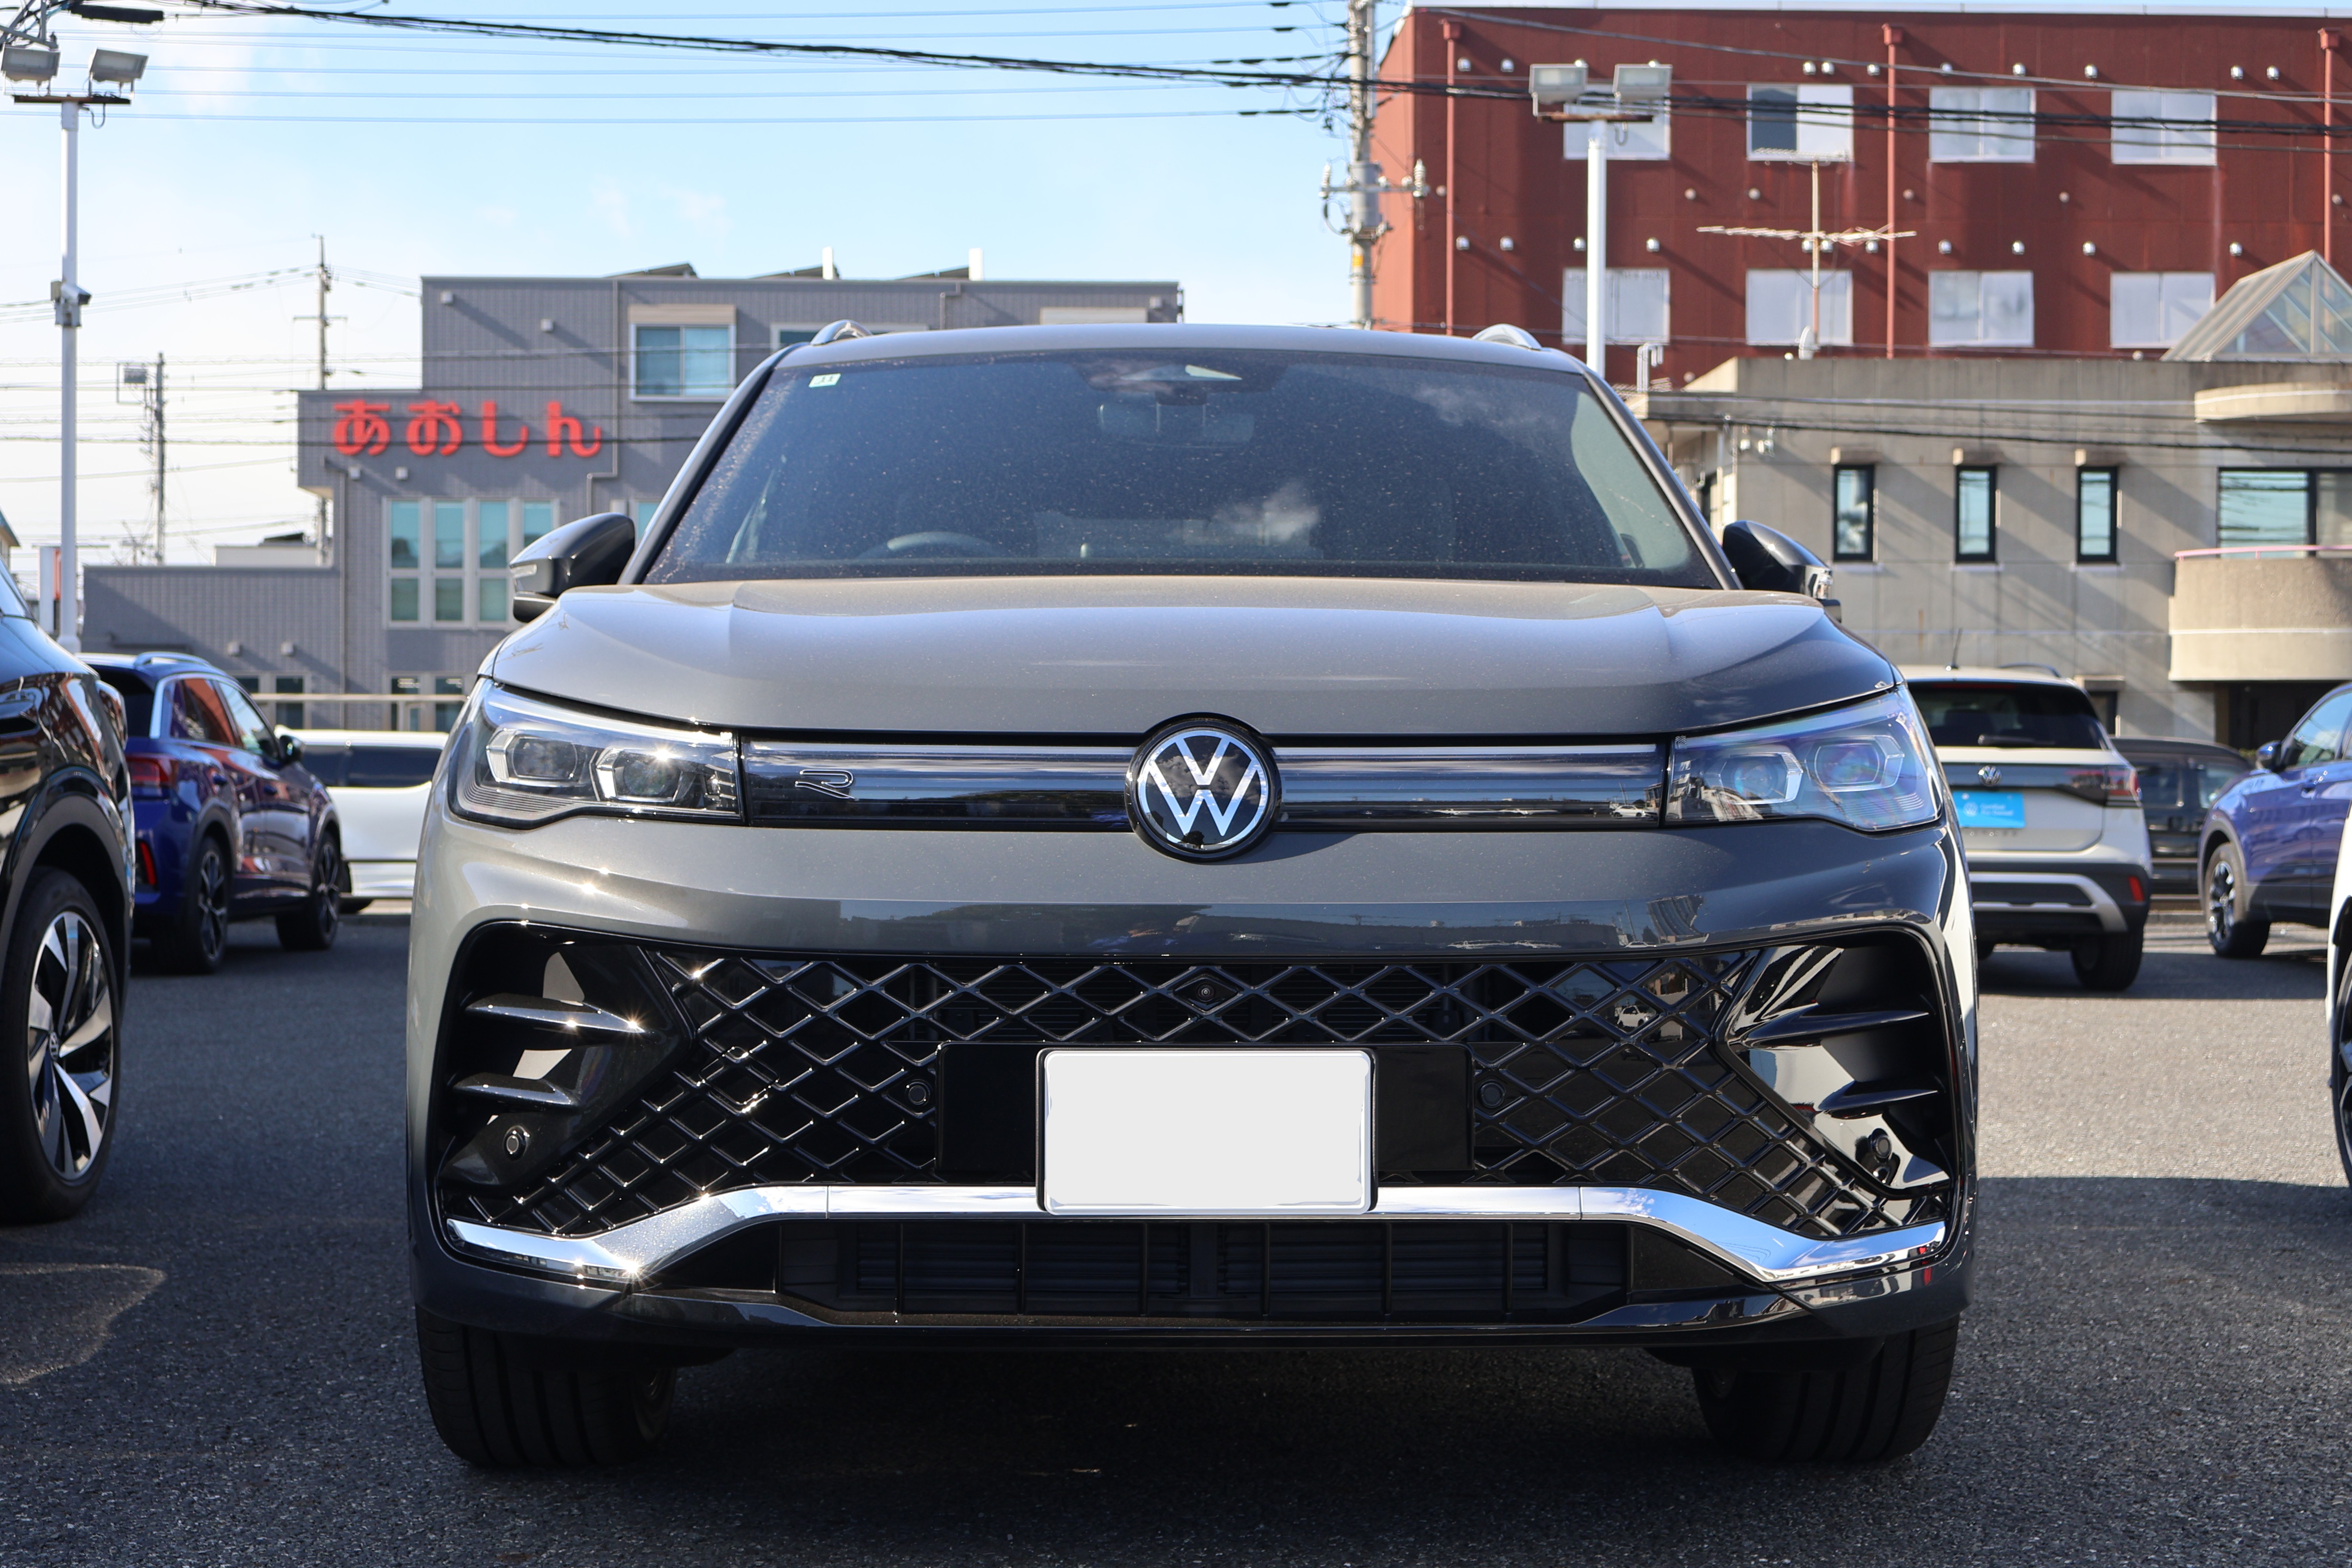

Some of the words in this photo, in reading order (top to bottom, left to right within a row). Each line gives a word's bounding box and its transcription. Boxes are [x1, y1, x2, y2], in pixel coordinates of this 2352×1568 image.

[333, 399, 601, 457] あおしん
[794, 768, 858, 800] R
[1139, 730, 1269, 849] VW
